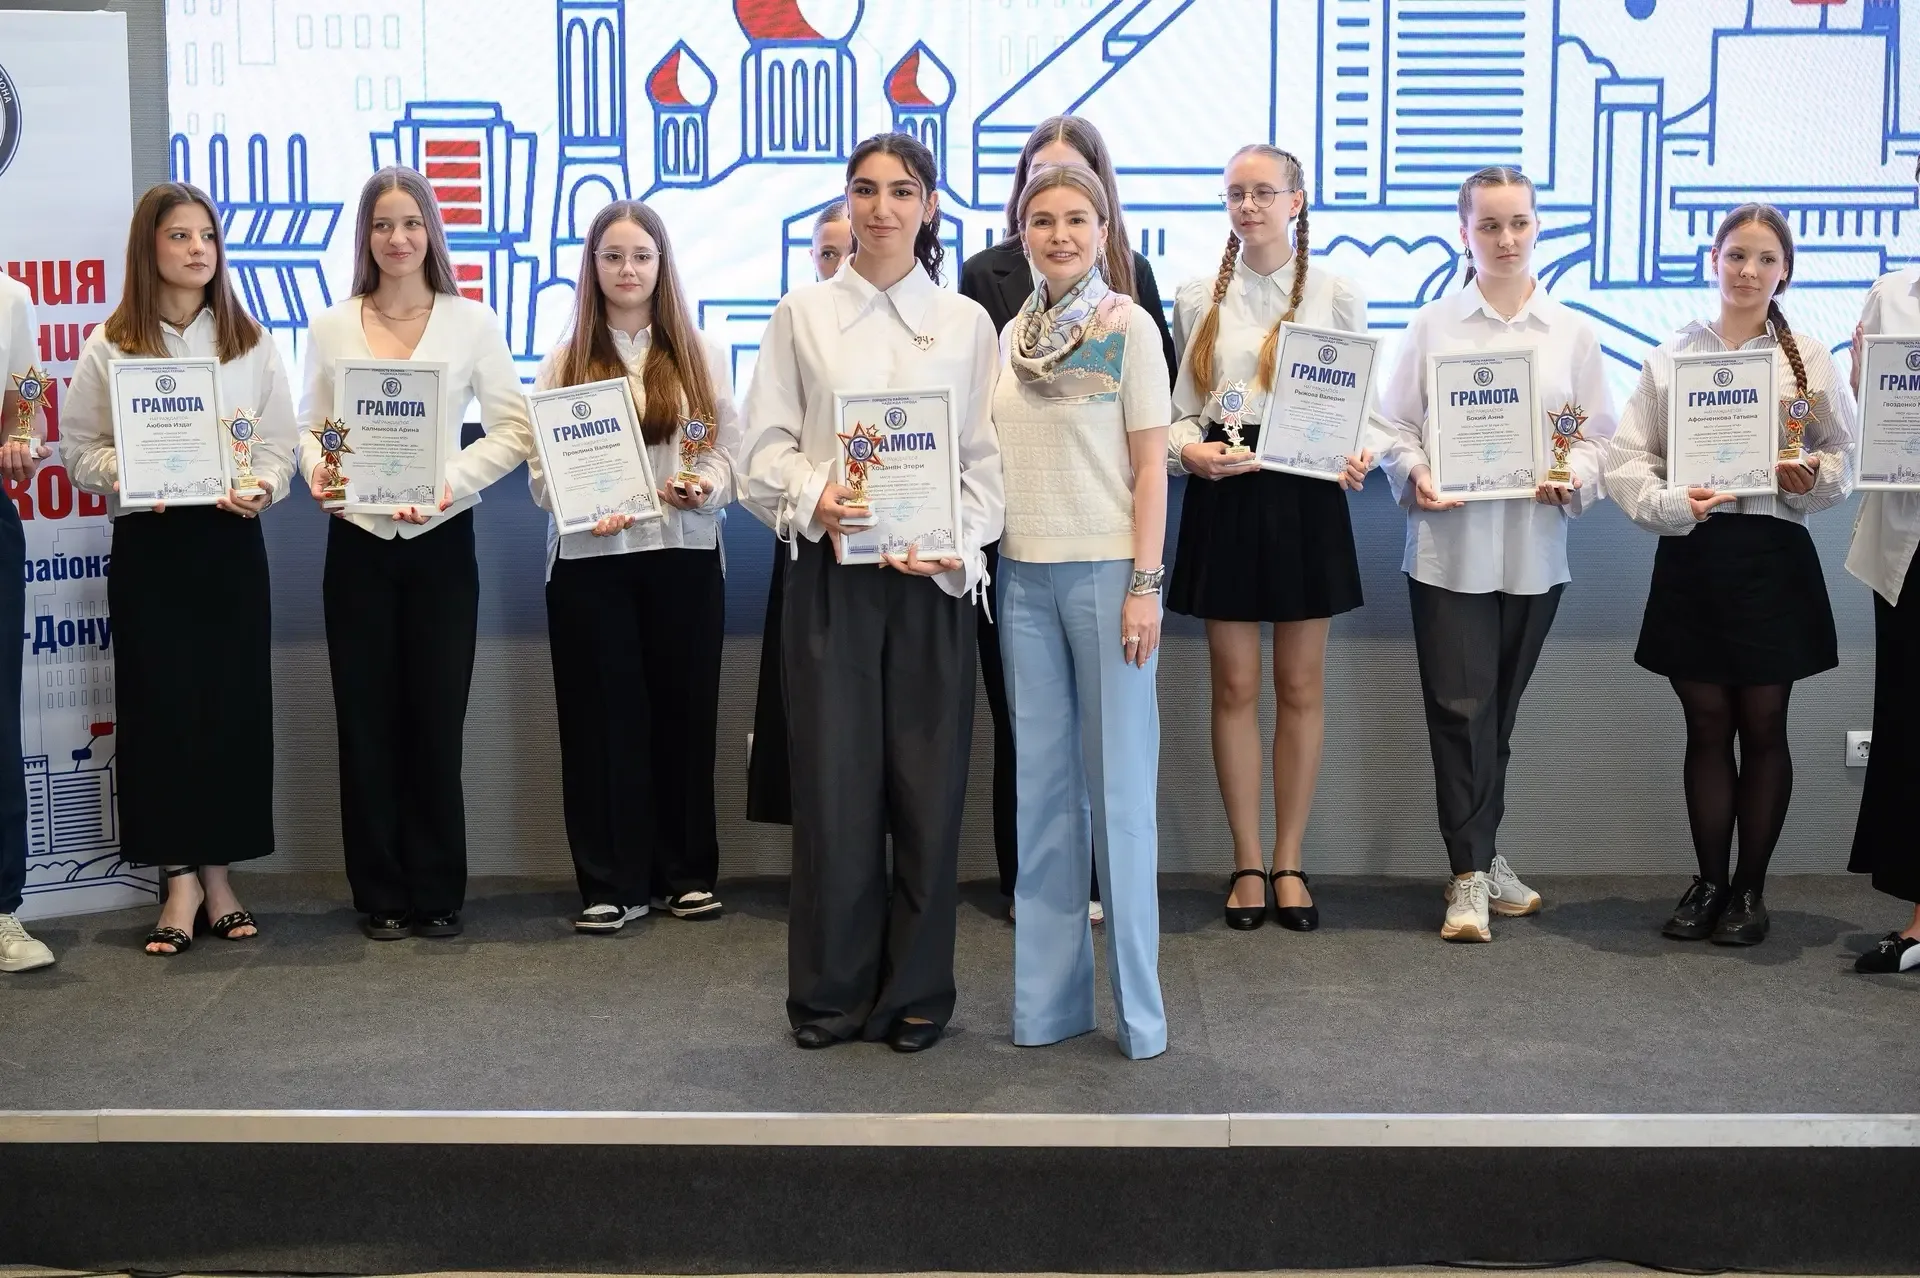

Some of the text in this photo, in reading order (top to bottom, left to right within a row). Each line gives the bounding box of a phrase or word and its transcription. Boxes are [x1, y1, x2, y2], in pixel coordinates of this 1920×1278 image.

[0, 260, 106, 305] ния
[1290, 363, 1356, 389] ГРАМОТА
[1879, 374, 1920, 391] ГРАМ
[132, 396, 204, 414] ГРАМОТА
[1450, 388, 1520, 407] ГРАМОТА
[1689, 388, 1758, 407] ГРАМОТА
[356, 400, 426, 417] ГРАМОТА
[552, 417, 622, 443] ГРАМОТА
[878, 432, 937, 453] АМОТА
